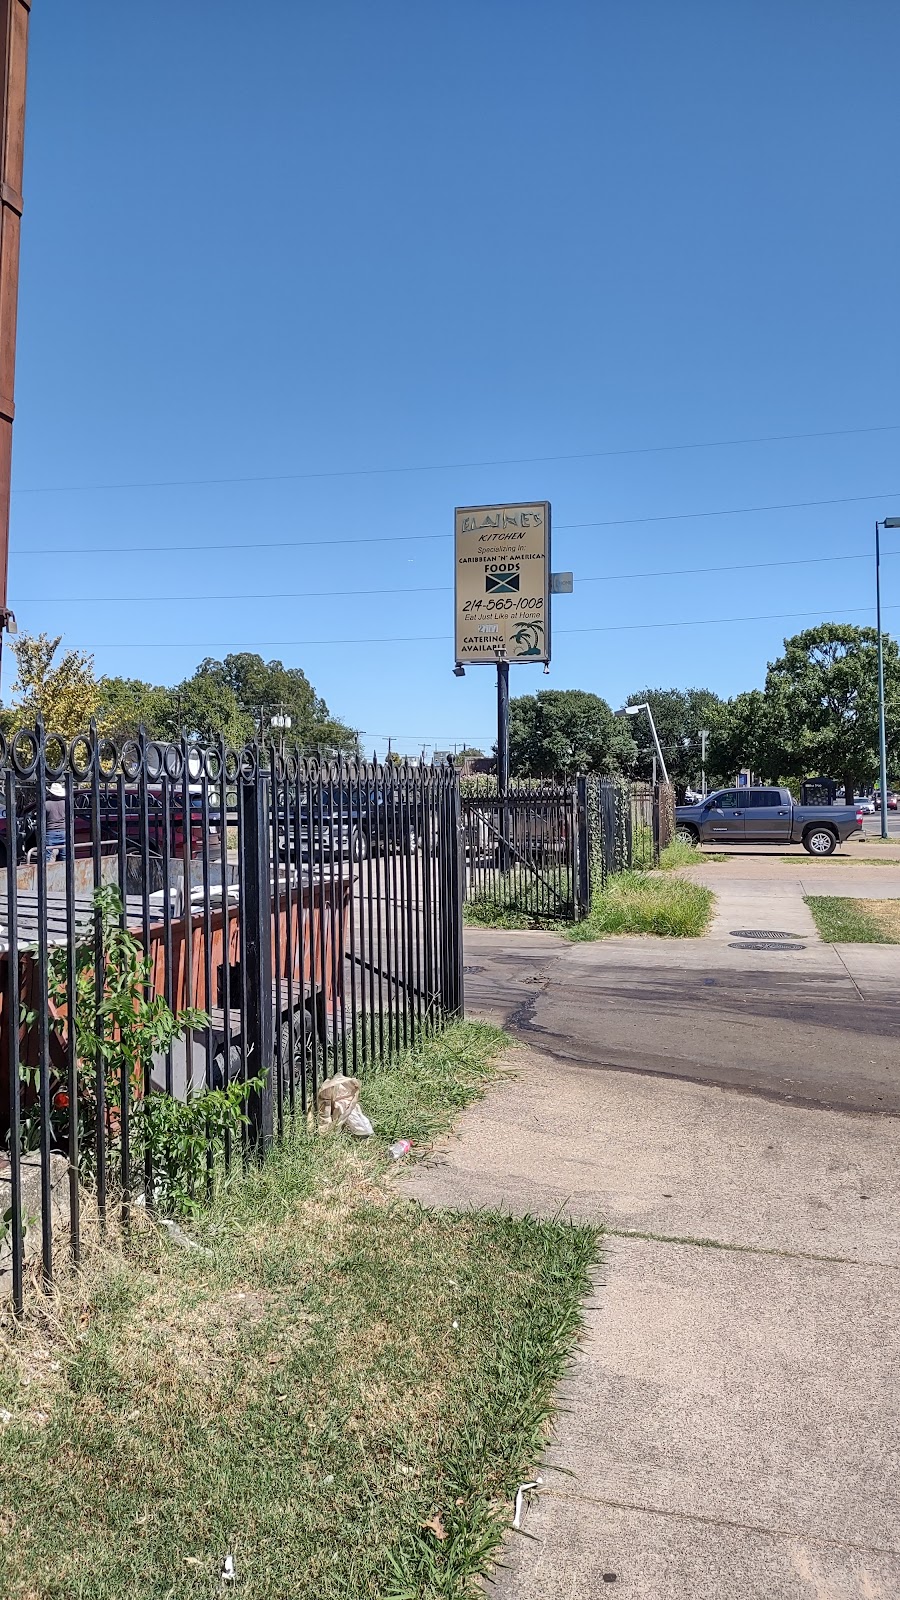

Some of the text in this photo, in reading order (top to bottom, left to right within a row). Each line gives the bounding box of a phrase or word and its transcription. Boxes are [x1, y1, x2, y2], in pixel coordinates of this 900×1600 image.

[478, 532, 527, 542] KITCHEN
[477, 545, 516, 555] Specializing
[458, 555, 497, 564] CARIBBEAN
[509, 553, 546, 561] AMERICAN
[484, 562, 521, 573] FOODS
[462, 597, 544, 612] 214-565-1008
[464, 613, 477, 621] Eat
[477, 613, 493, 621] Just
[494, 612, 509, 620] Like
[519, 611, 541, 619] Home
[463, 635, 504, 644] CATERING
